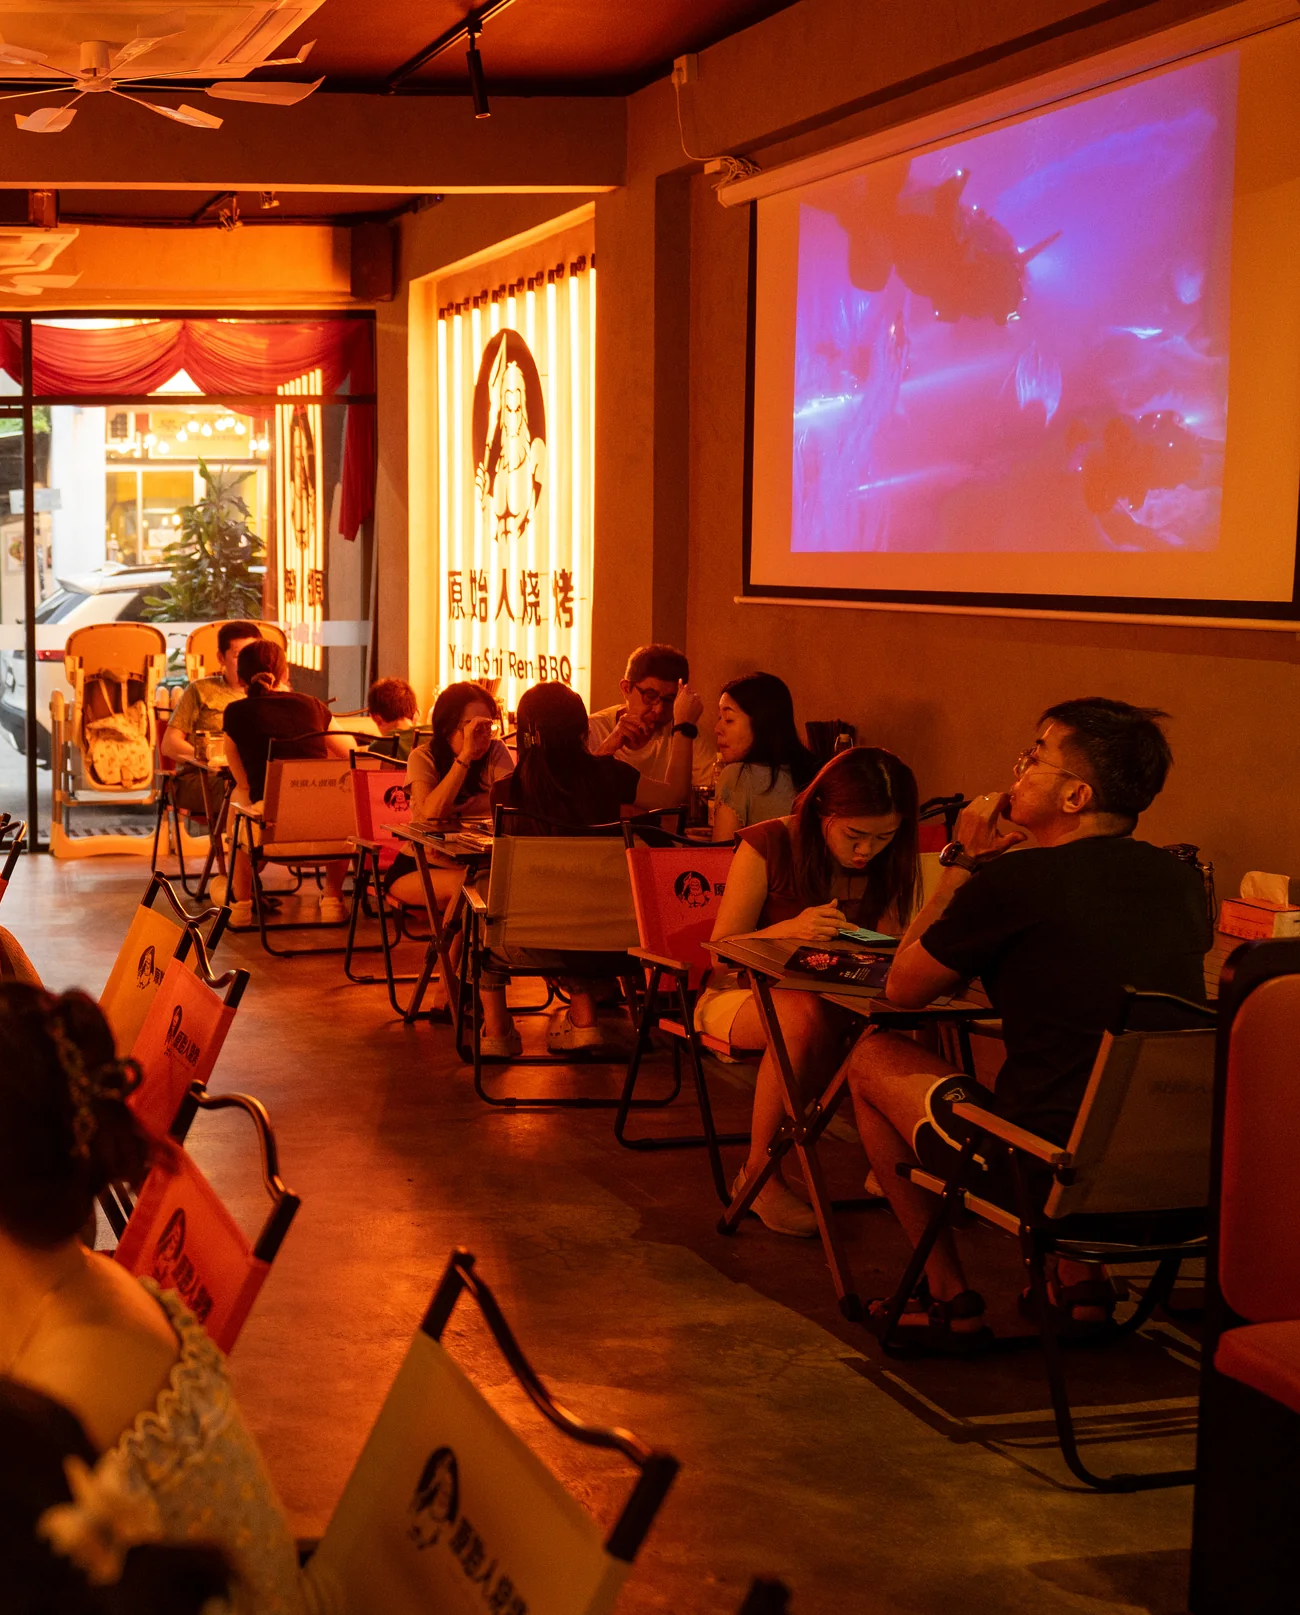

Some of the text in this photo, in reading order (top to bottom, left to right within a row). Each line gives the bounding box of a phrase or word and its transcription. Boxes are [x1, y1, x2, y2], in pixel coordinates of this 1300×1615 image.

[448, 568, 574, 629] 原始人烧烤
[509, 651, 534, 680] Ren
[538, 654, 572, 687] BBQ
